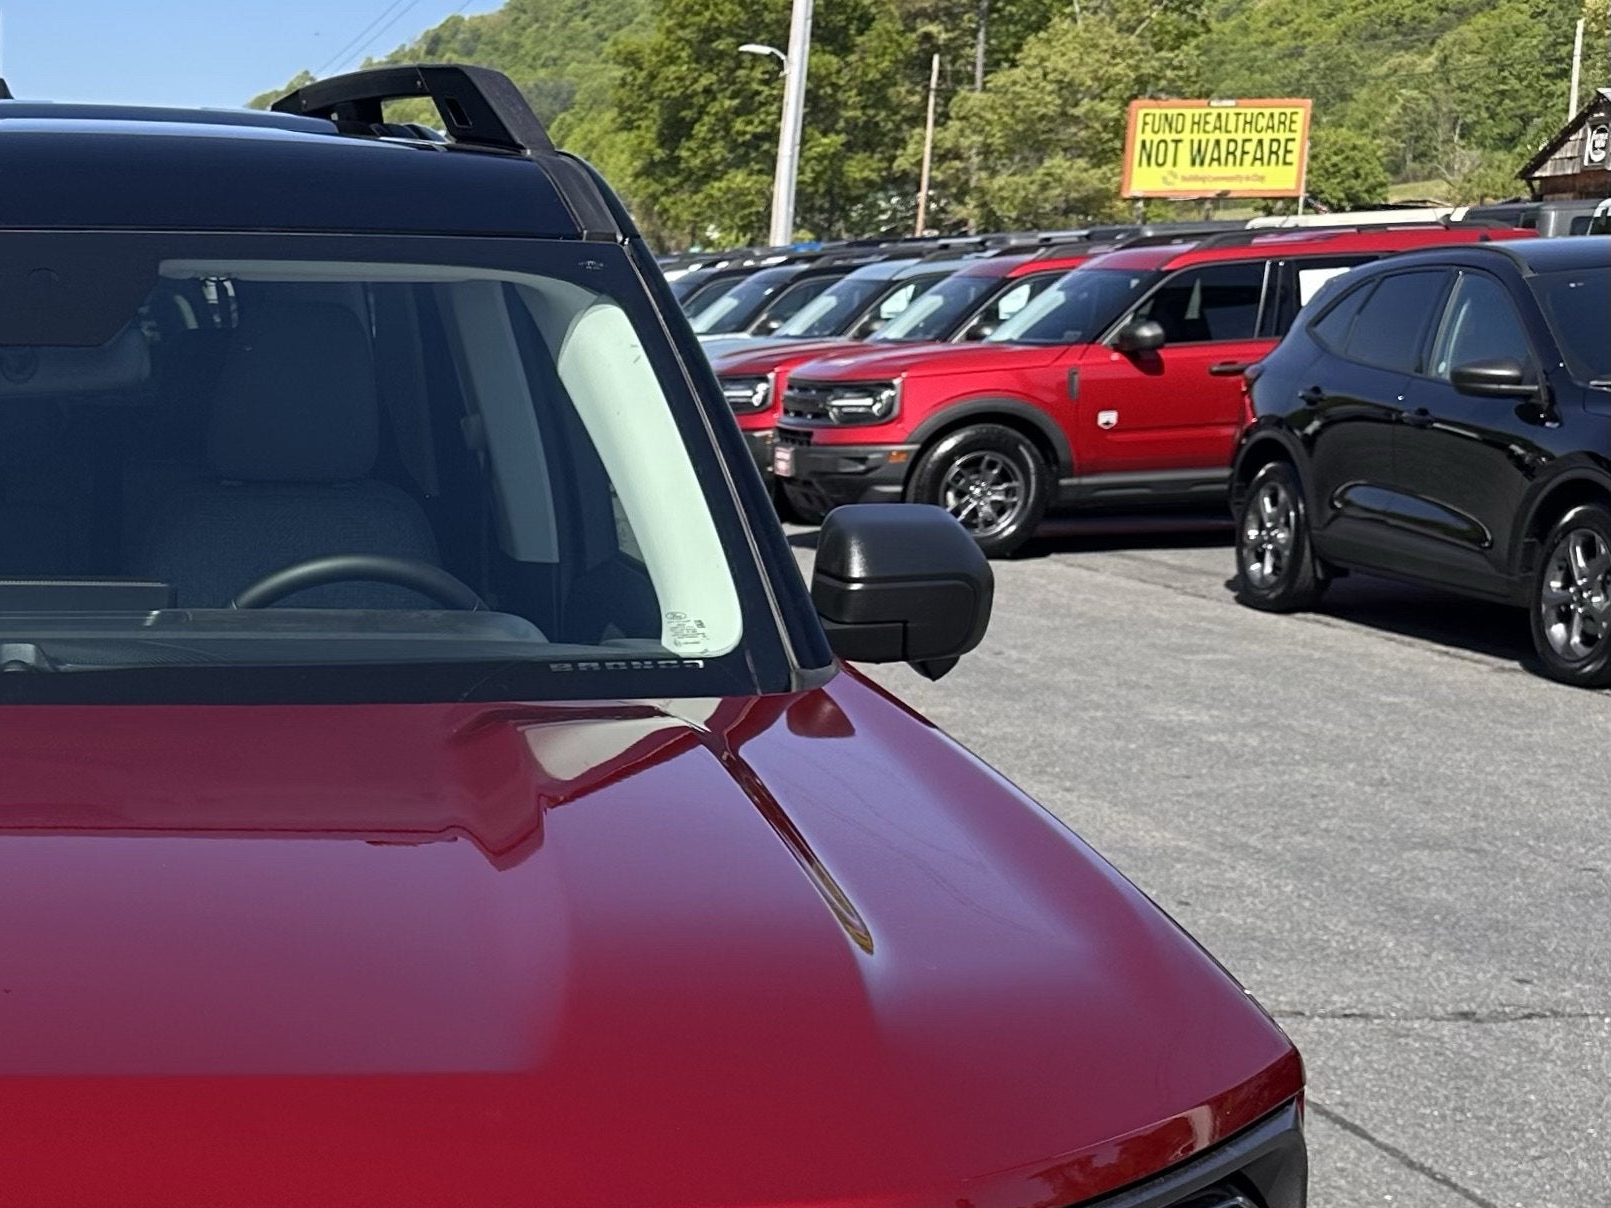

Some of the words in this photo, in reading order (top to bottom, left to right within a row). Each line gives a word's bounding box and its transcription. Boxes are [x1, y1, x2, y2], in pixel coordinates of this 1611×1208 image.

[1141, 112, 1186, 134] FUND
[1190, 111, 1299, 134] HEALTHCARE
[1138, 138, 1183, 168] NOT
[1190, 138, 1296, 168] WARFARE
